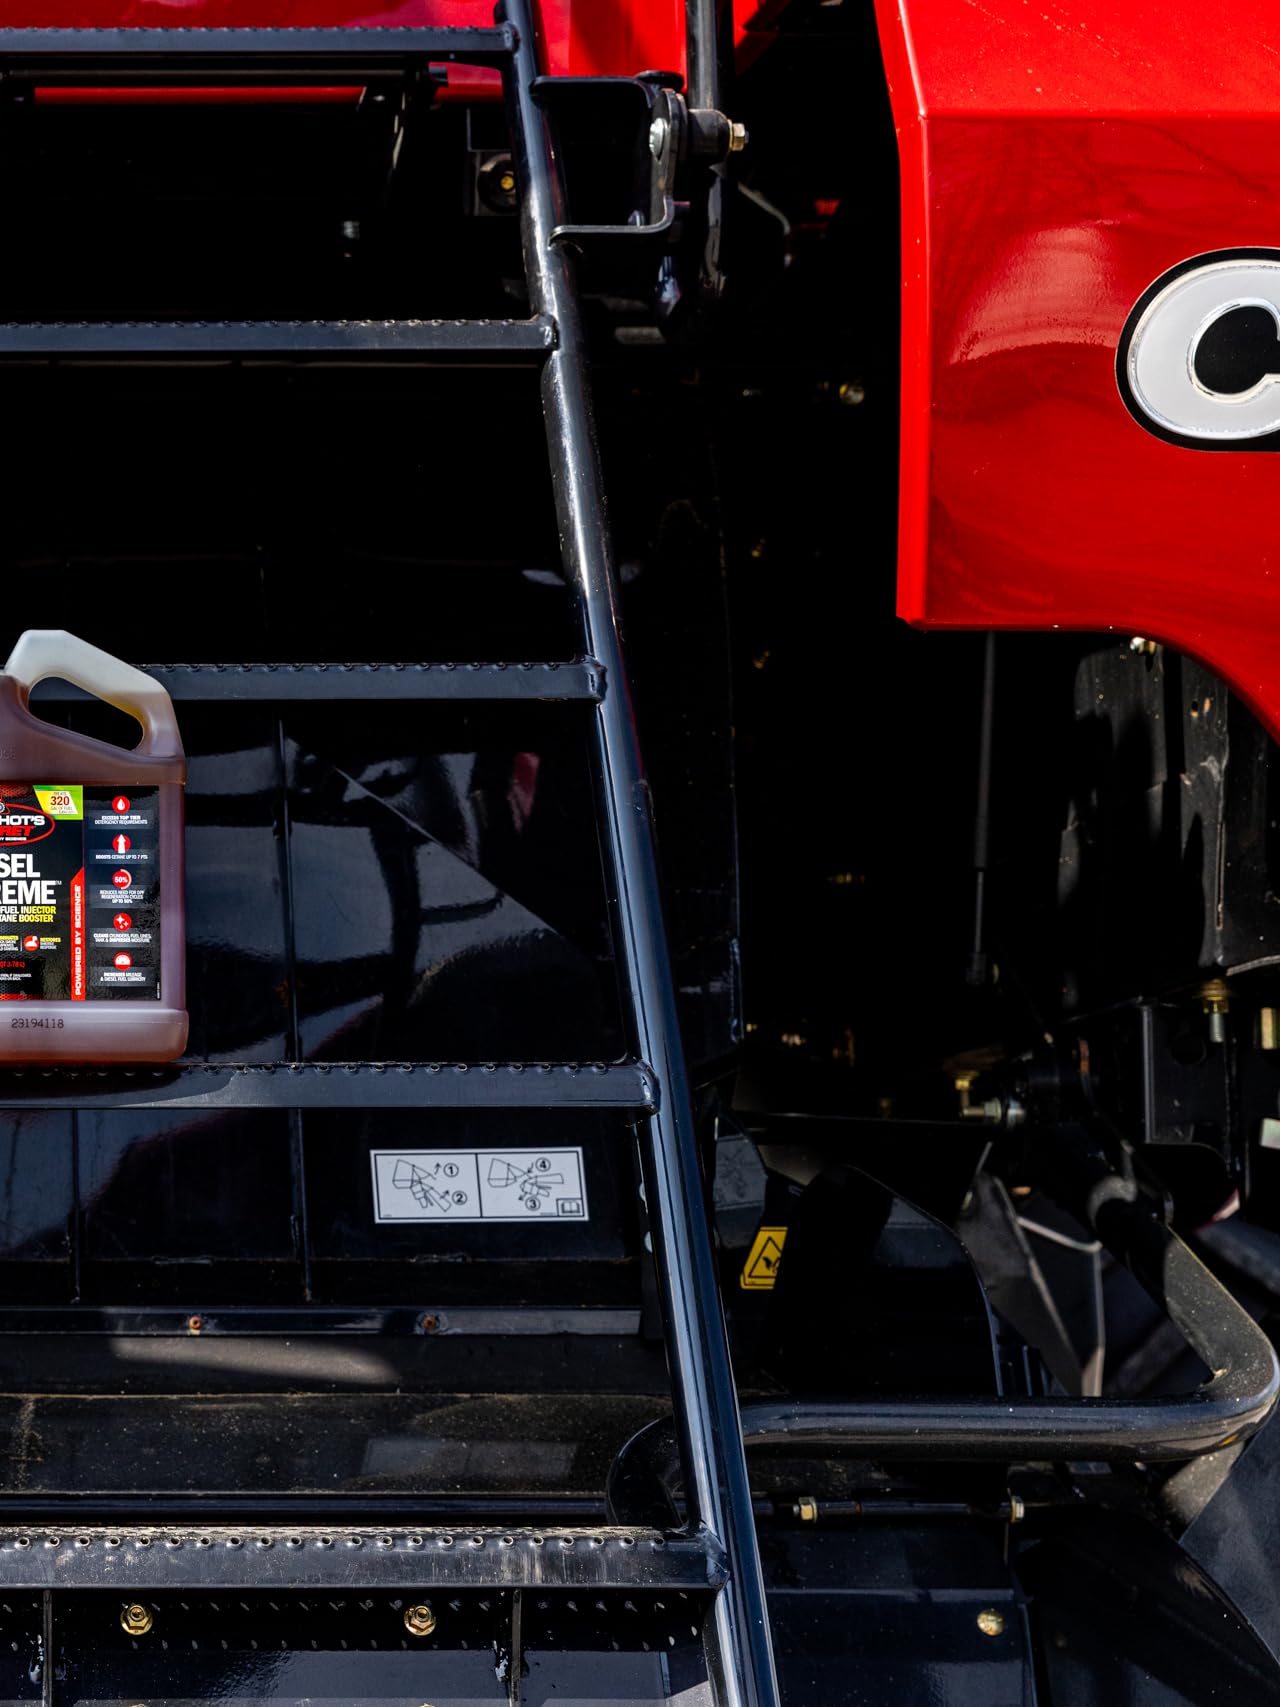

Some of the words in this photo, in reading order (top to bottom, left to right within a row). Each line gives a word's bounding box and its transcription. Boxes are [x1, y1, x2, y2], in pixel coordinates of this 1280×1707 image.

[50, 796, 70, 806] 320
[0, 906, 19, 914] FUEL
[21, 906, 57, 914] INJECTOR
[20, 914, 54, 922] BOOSTER
[75, 931, 81, 944] BY
[11, 1018, 64, 1029] 23194118
